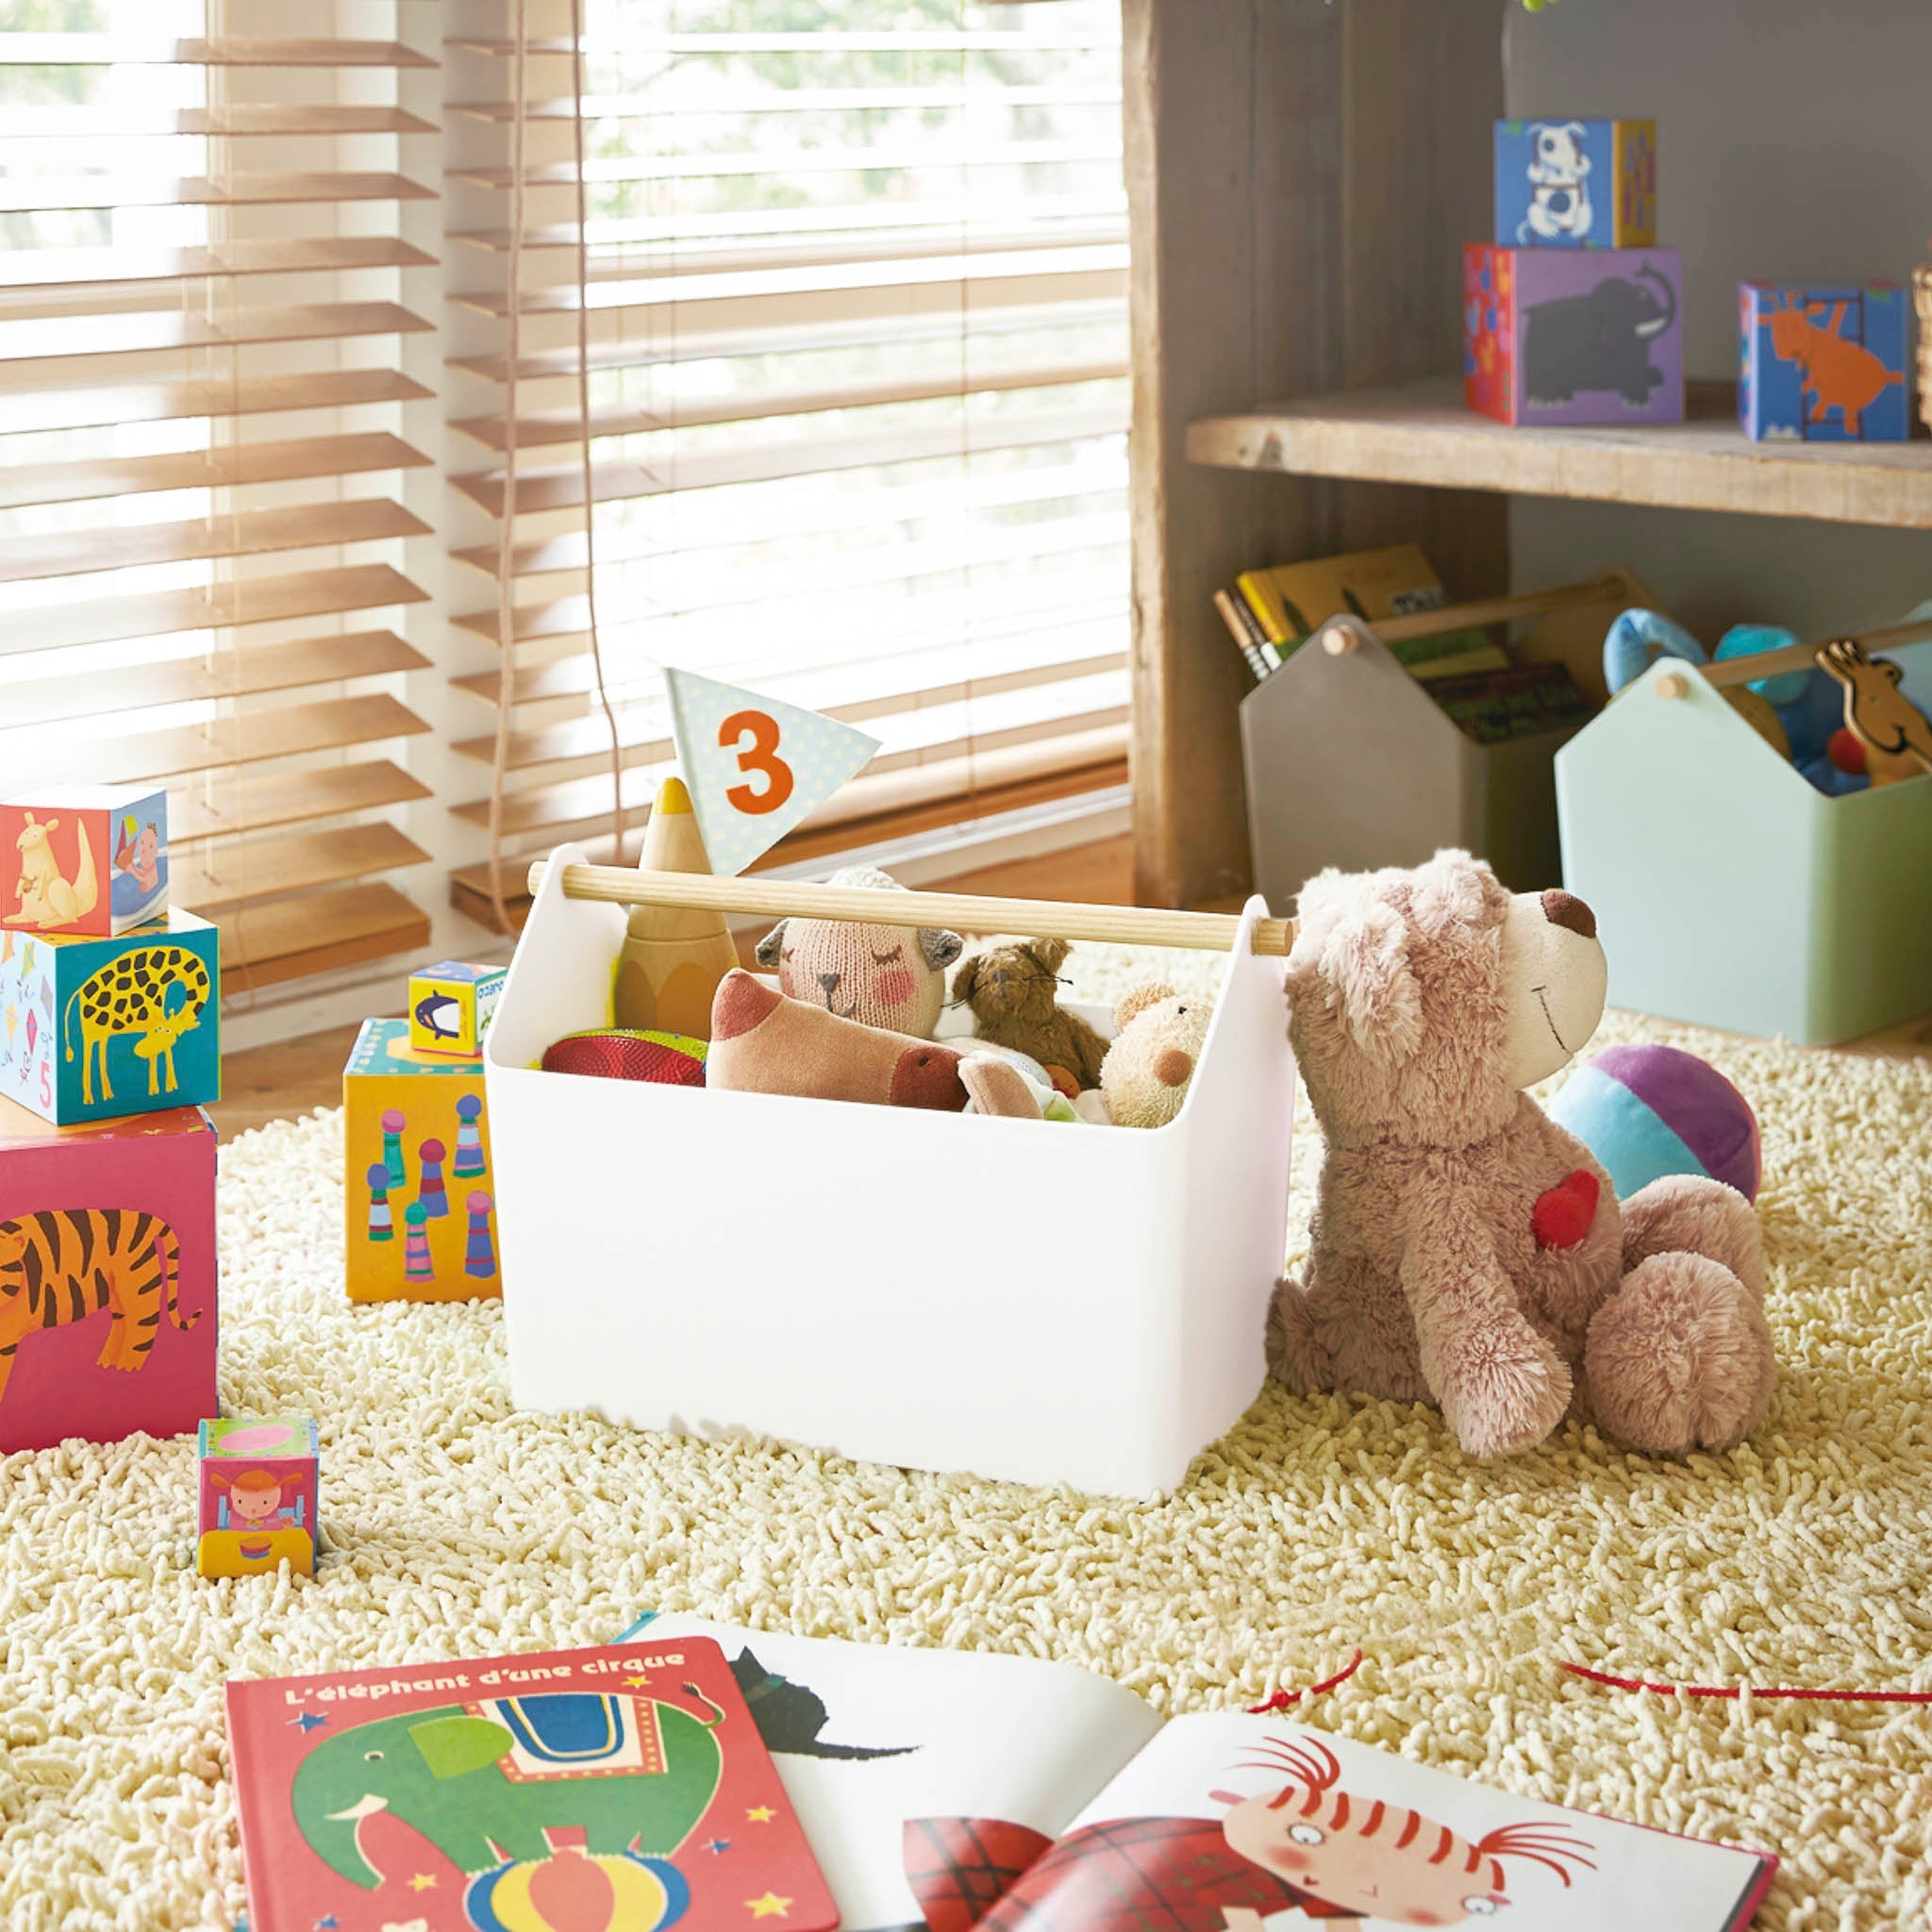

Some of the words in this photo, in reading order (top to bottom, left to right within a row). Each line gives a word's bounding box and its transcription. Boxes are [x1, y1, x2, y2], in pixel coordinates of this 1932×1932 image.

[719, 709, 794, 816] 3
[40, 1060, 52, 1109] 5
[285, 1674, 471, 1706] L'éléphant
[478, 1665, 573, 1686] d'une
[581, 1653, 685, 1674] cirque
